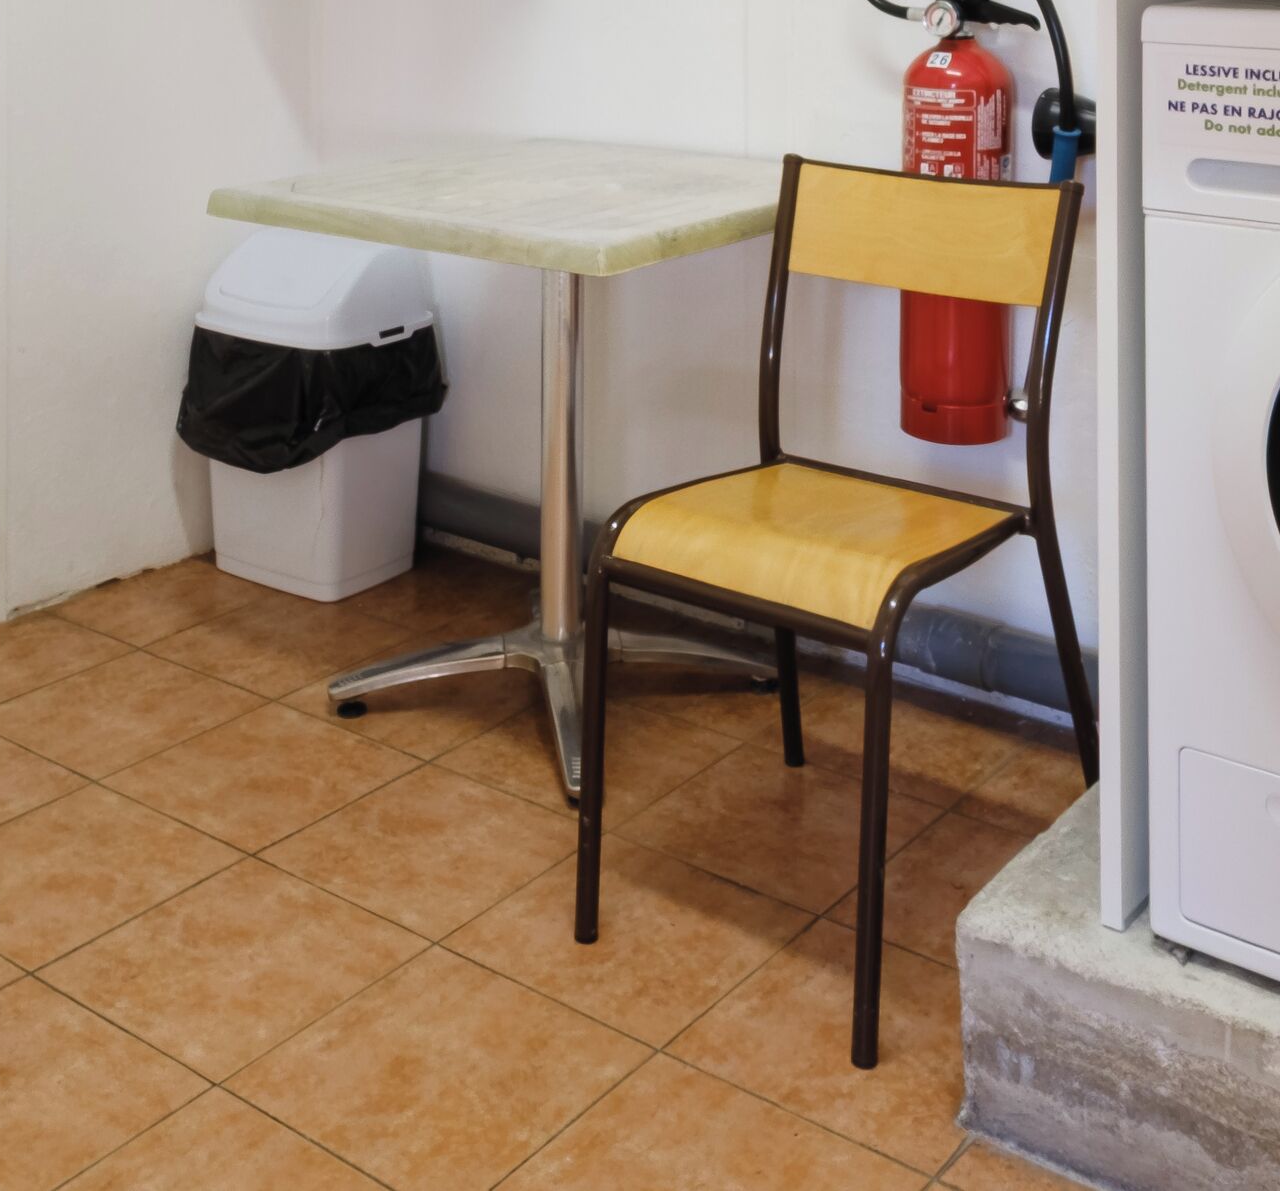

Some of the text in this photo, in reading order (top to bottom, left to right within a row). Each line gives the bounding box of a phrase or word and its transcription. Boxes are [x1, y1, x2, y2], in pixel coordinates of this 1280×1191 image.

[1185, 64, 1239, 79] LESSIVE
[1177, 78, 1248, 96] Detergent
[1168, 100, 1186, 112] NE
[1191, 102, 1218, 115] PAS
[1223, 105, 1242, 117] EN
[1204, 119, 1223, 132] Do
[1228, 123, 1251, 135] not
